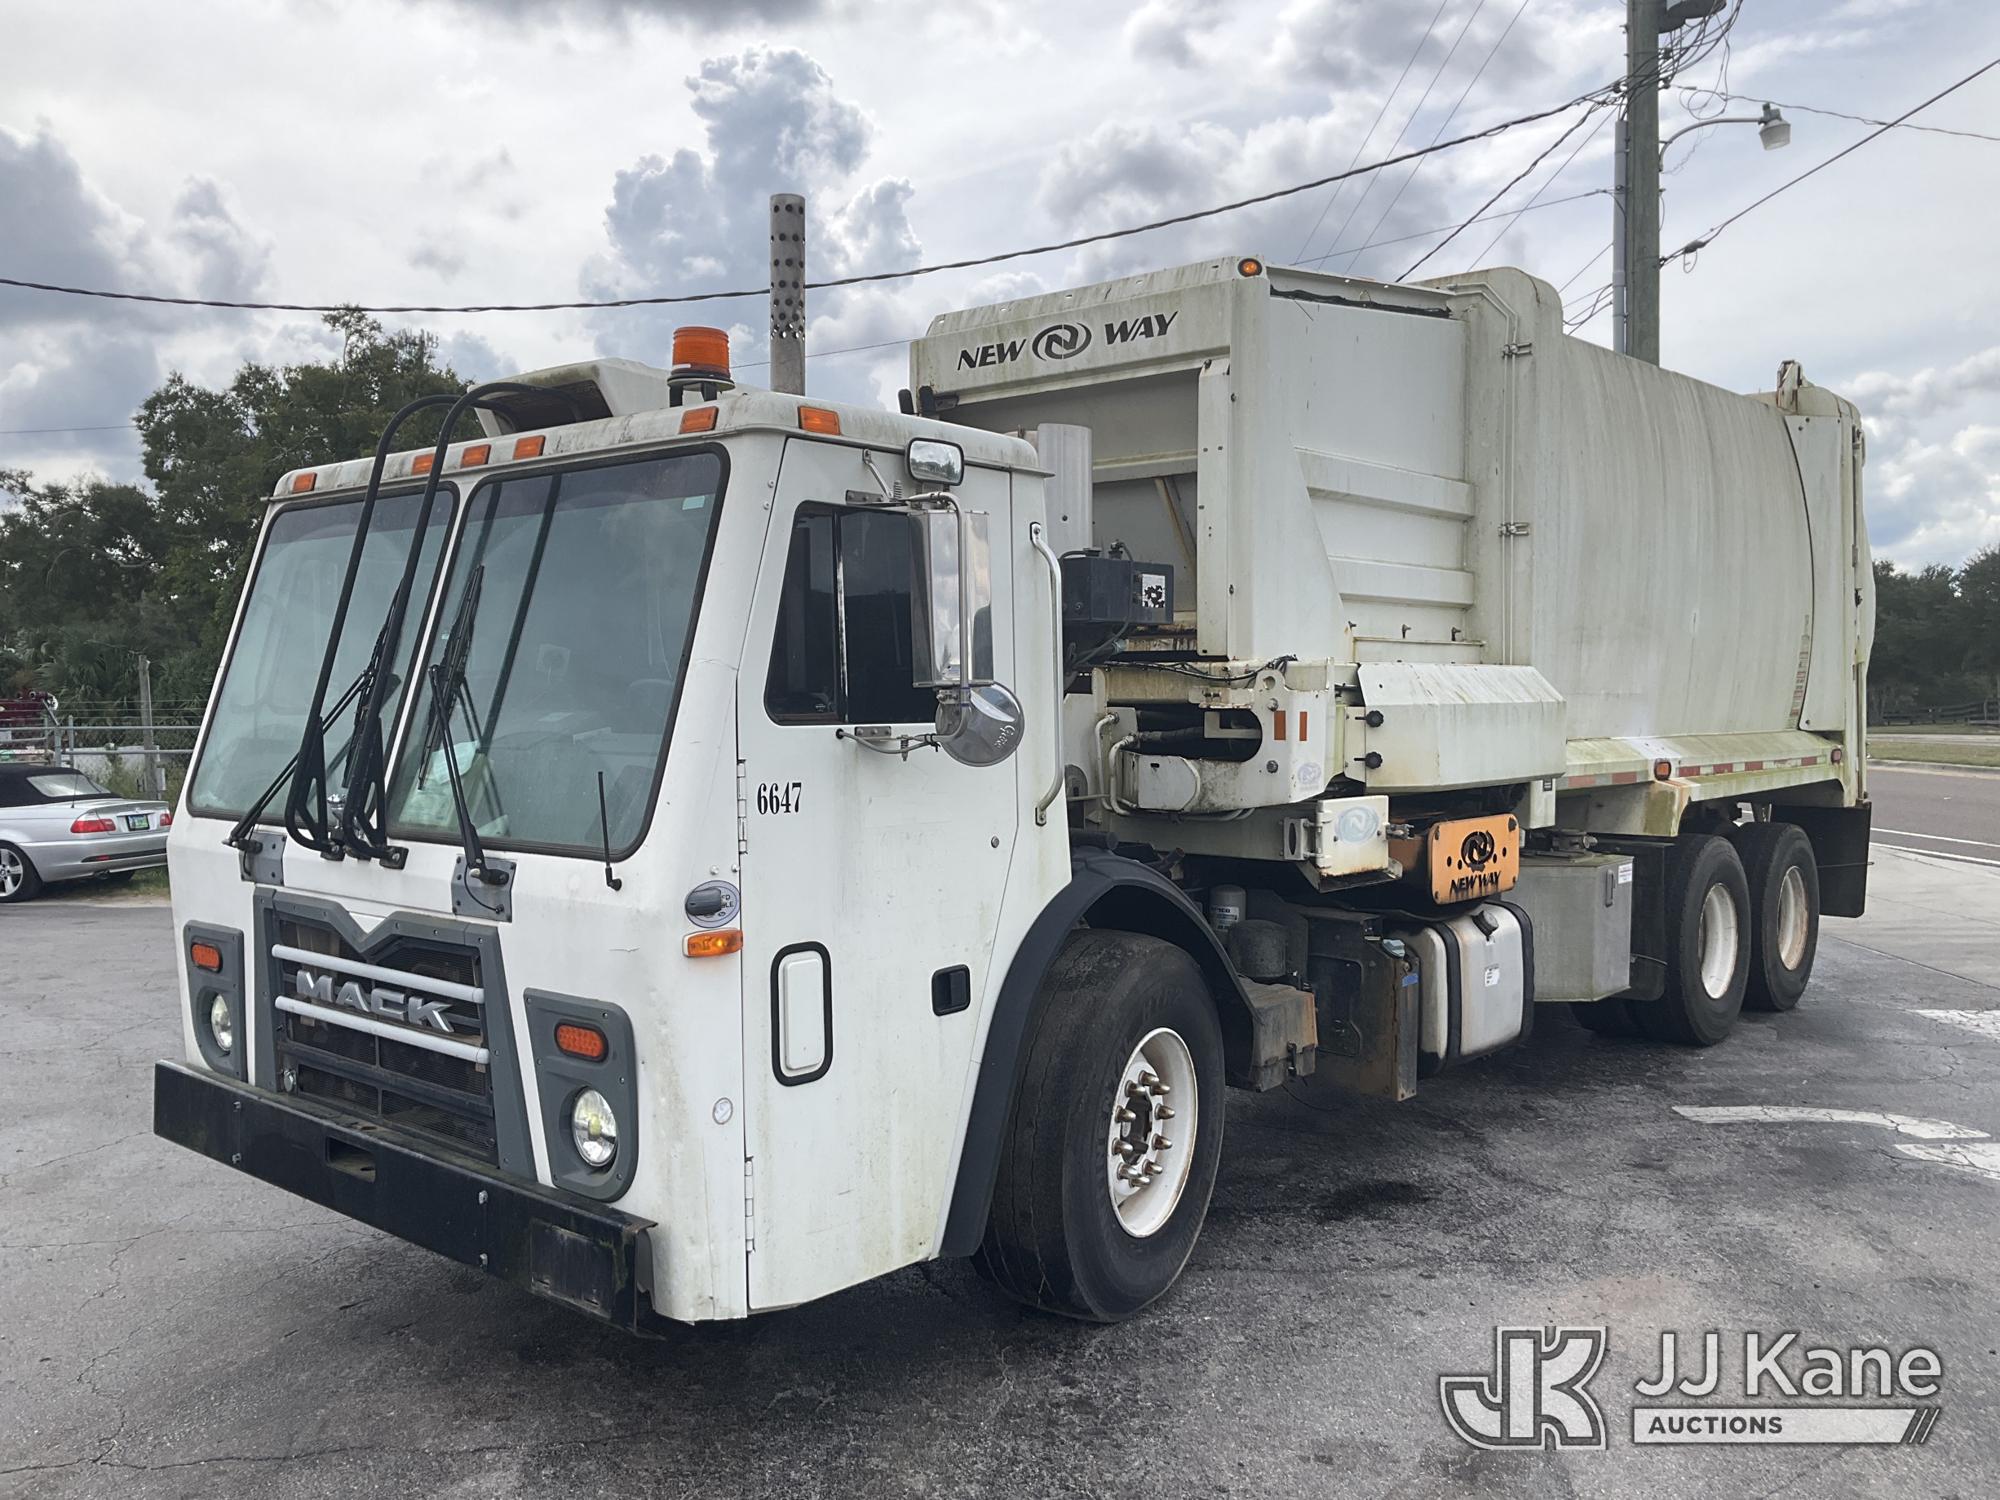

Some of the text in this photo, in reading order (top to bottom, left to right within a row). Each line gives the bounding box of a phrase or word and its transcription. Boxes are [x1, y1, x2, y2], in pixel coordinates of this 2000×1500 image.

[958, 339, 1026, 370] NEW
[1105, 311, 1179, 344] WAY
[757, 782, 802, 815] 6647
[1449, 871, 1501, 894] NEW WAY
[296, 970, 455, 1033] MACK
